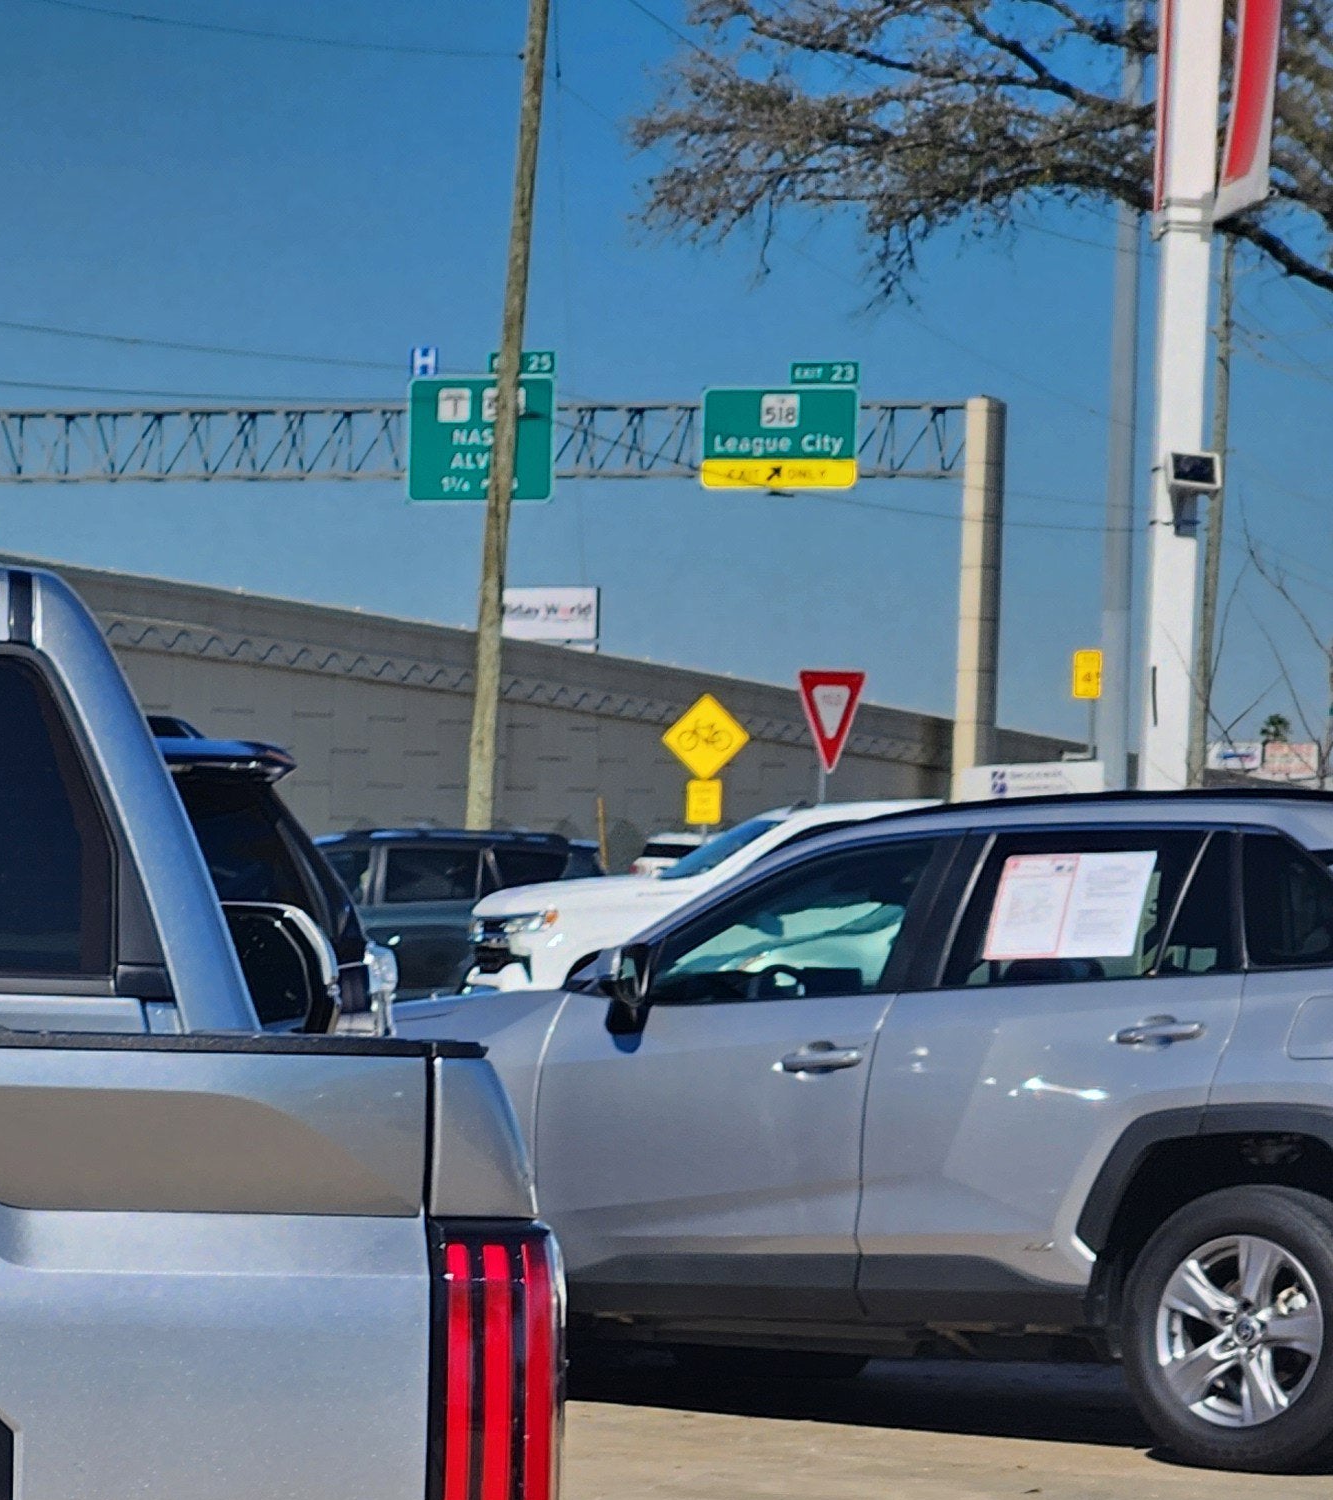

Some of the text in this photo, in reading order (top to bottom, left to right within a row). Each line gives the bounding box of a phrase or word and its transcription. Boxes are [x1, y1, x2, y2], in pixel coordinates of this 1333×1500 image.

[528, 354, 552, 371] 25
[794, 364, 855, 381] EXIT 23
[765, 406, 796, 424] 518
[452, 428, 494, 446] NAS
[713, 433, 844, 456] League City
[450, 452, 490, 469] ALV
